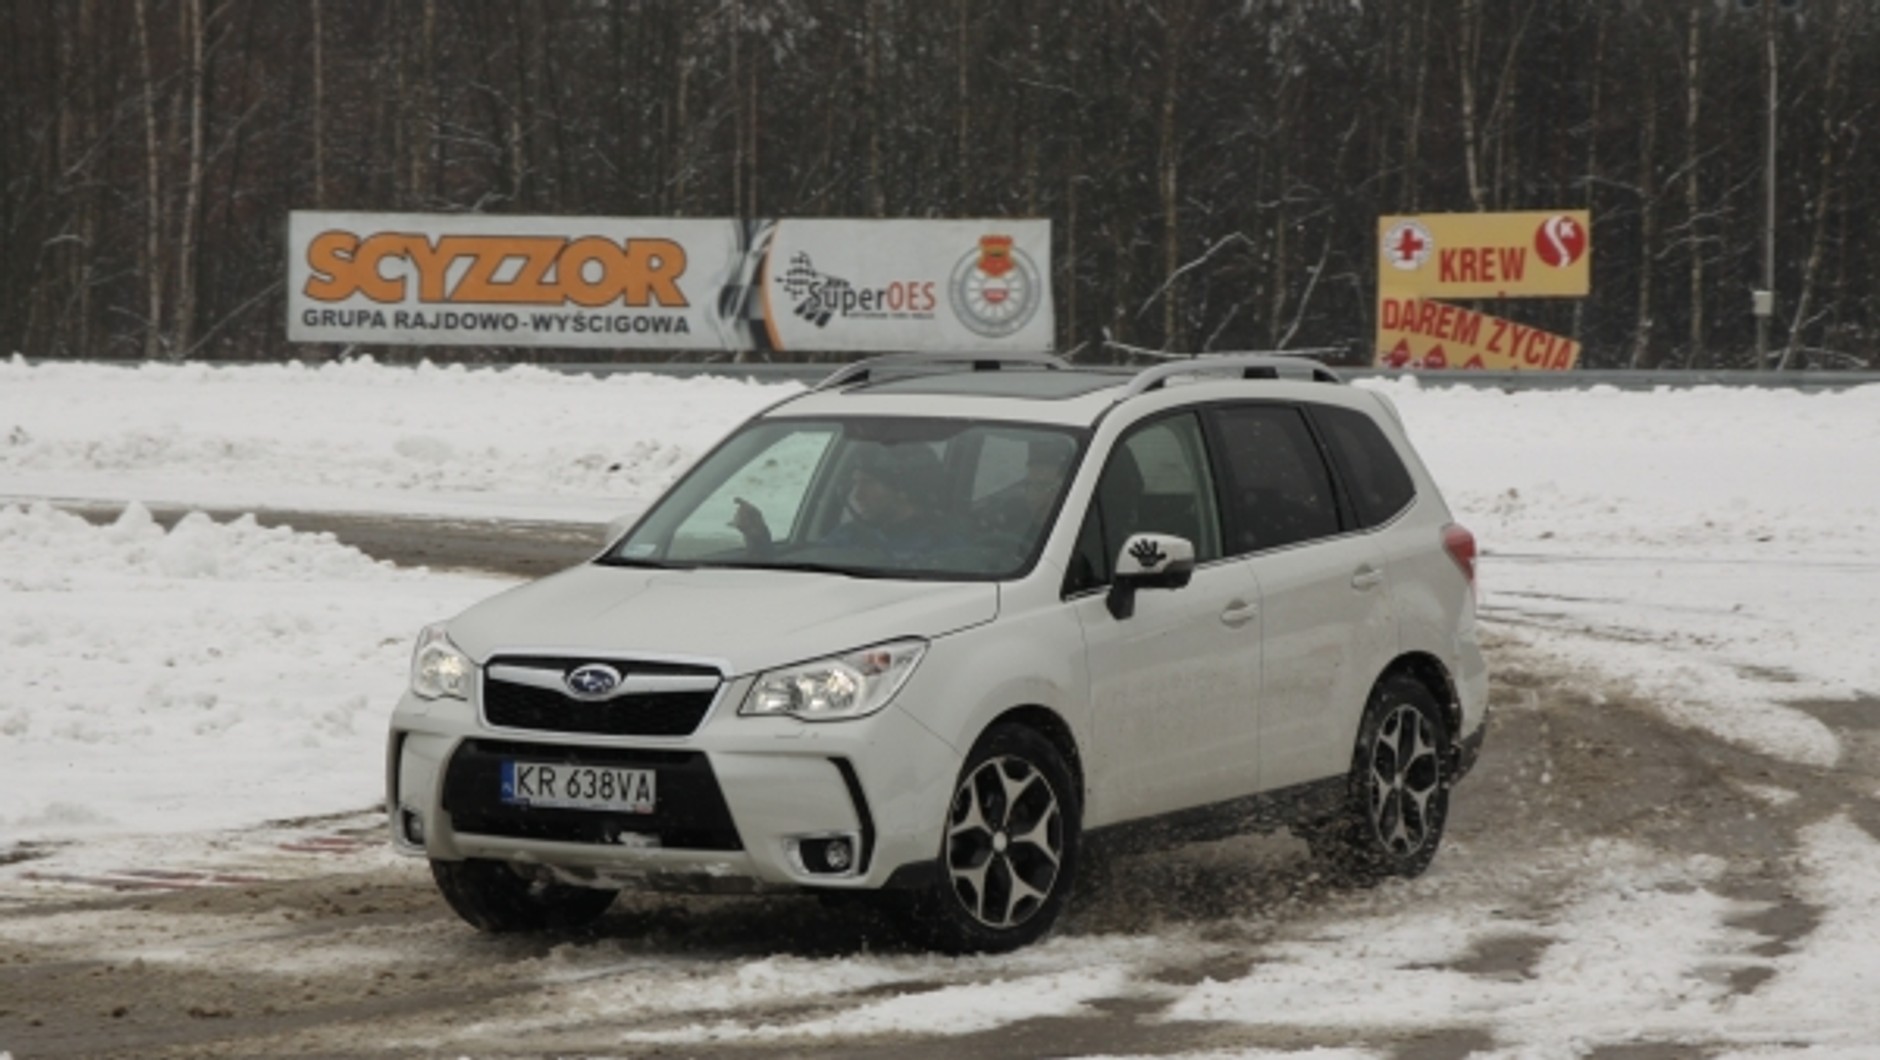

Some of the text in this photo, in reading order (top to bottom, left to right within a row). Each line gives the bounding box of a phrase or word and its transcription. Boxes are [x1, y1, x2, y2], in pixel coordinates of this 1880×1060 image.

[303, 230, 689, 307] SCYZZOR
[1438, 247, 1526, 283] KREW
[302, 308, 690, 334] GRUPA RAJDOWO-WYŚCIGOWA
[1382, 298, 1482, 346] DAREM
[516, 766, 650, 802] KR 638VA
